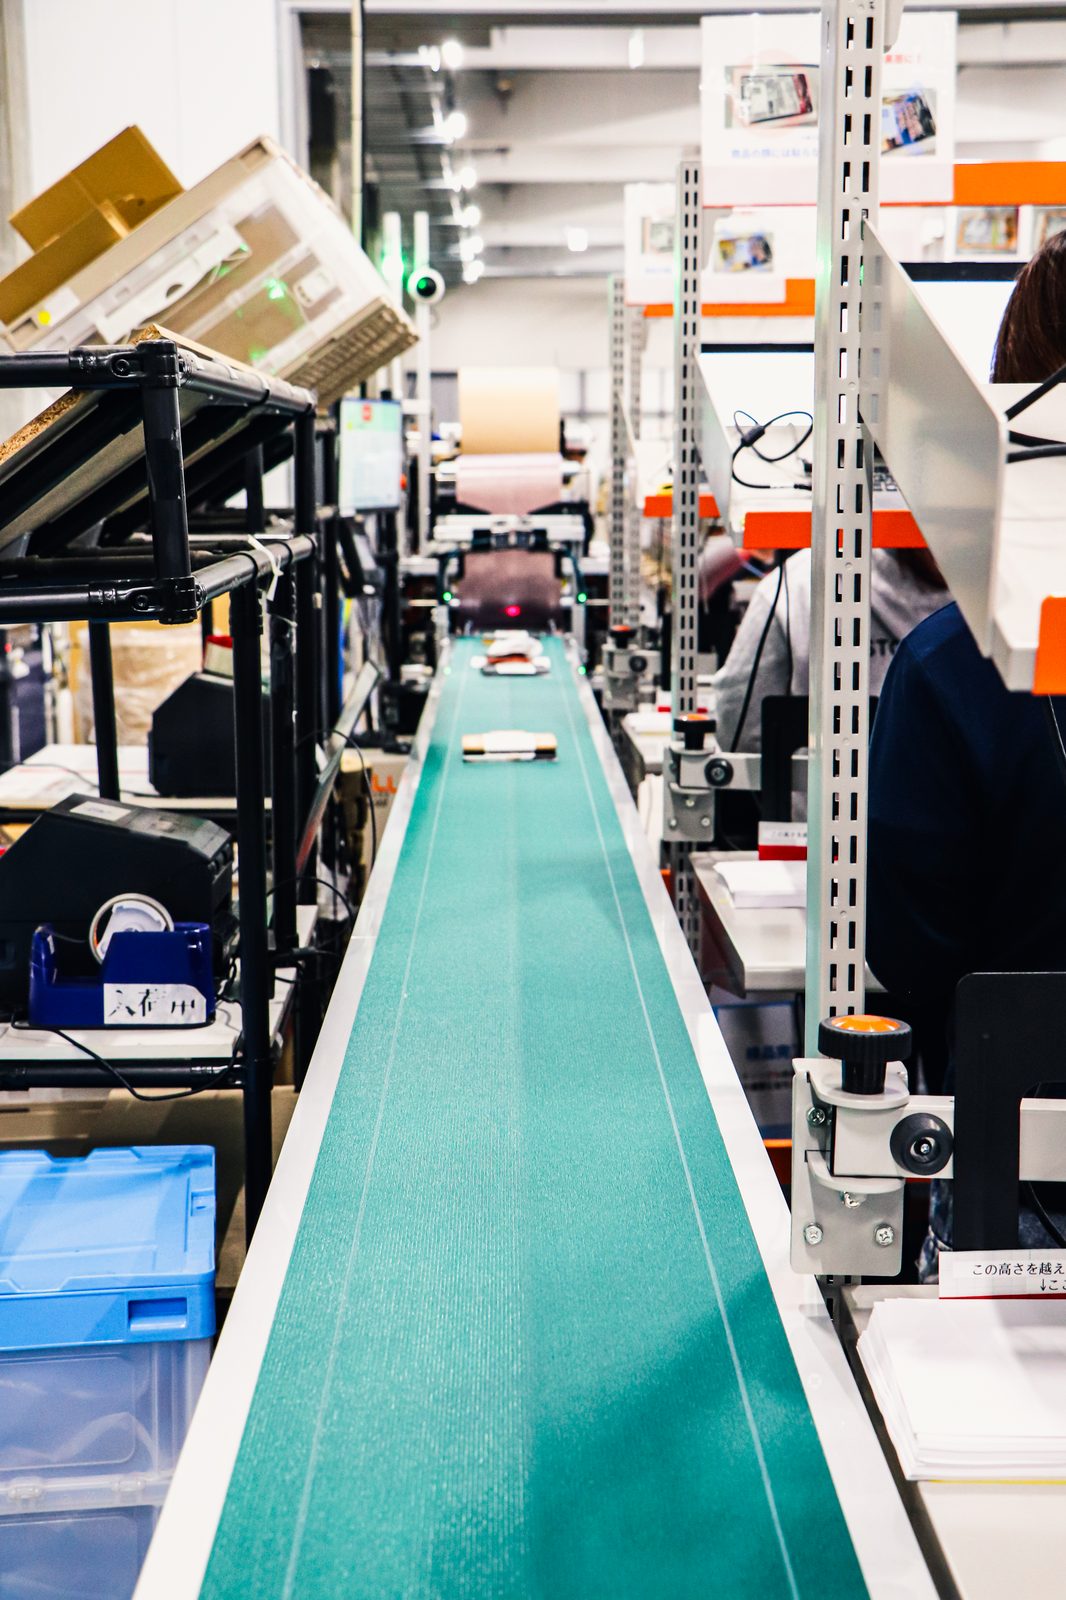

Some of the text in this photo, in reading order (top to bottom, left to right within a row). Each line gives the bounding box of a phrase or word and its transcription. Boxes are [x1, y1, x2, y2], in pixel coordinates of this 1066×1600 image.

[973, 1262, 1065, 1276] この高さを越え
